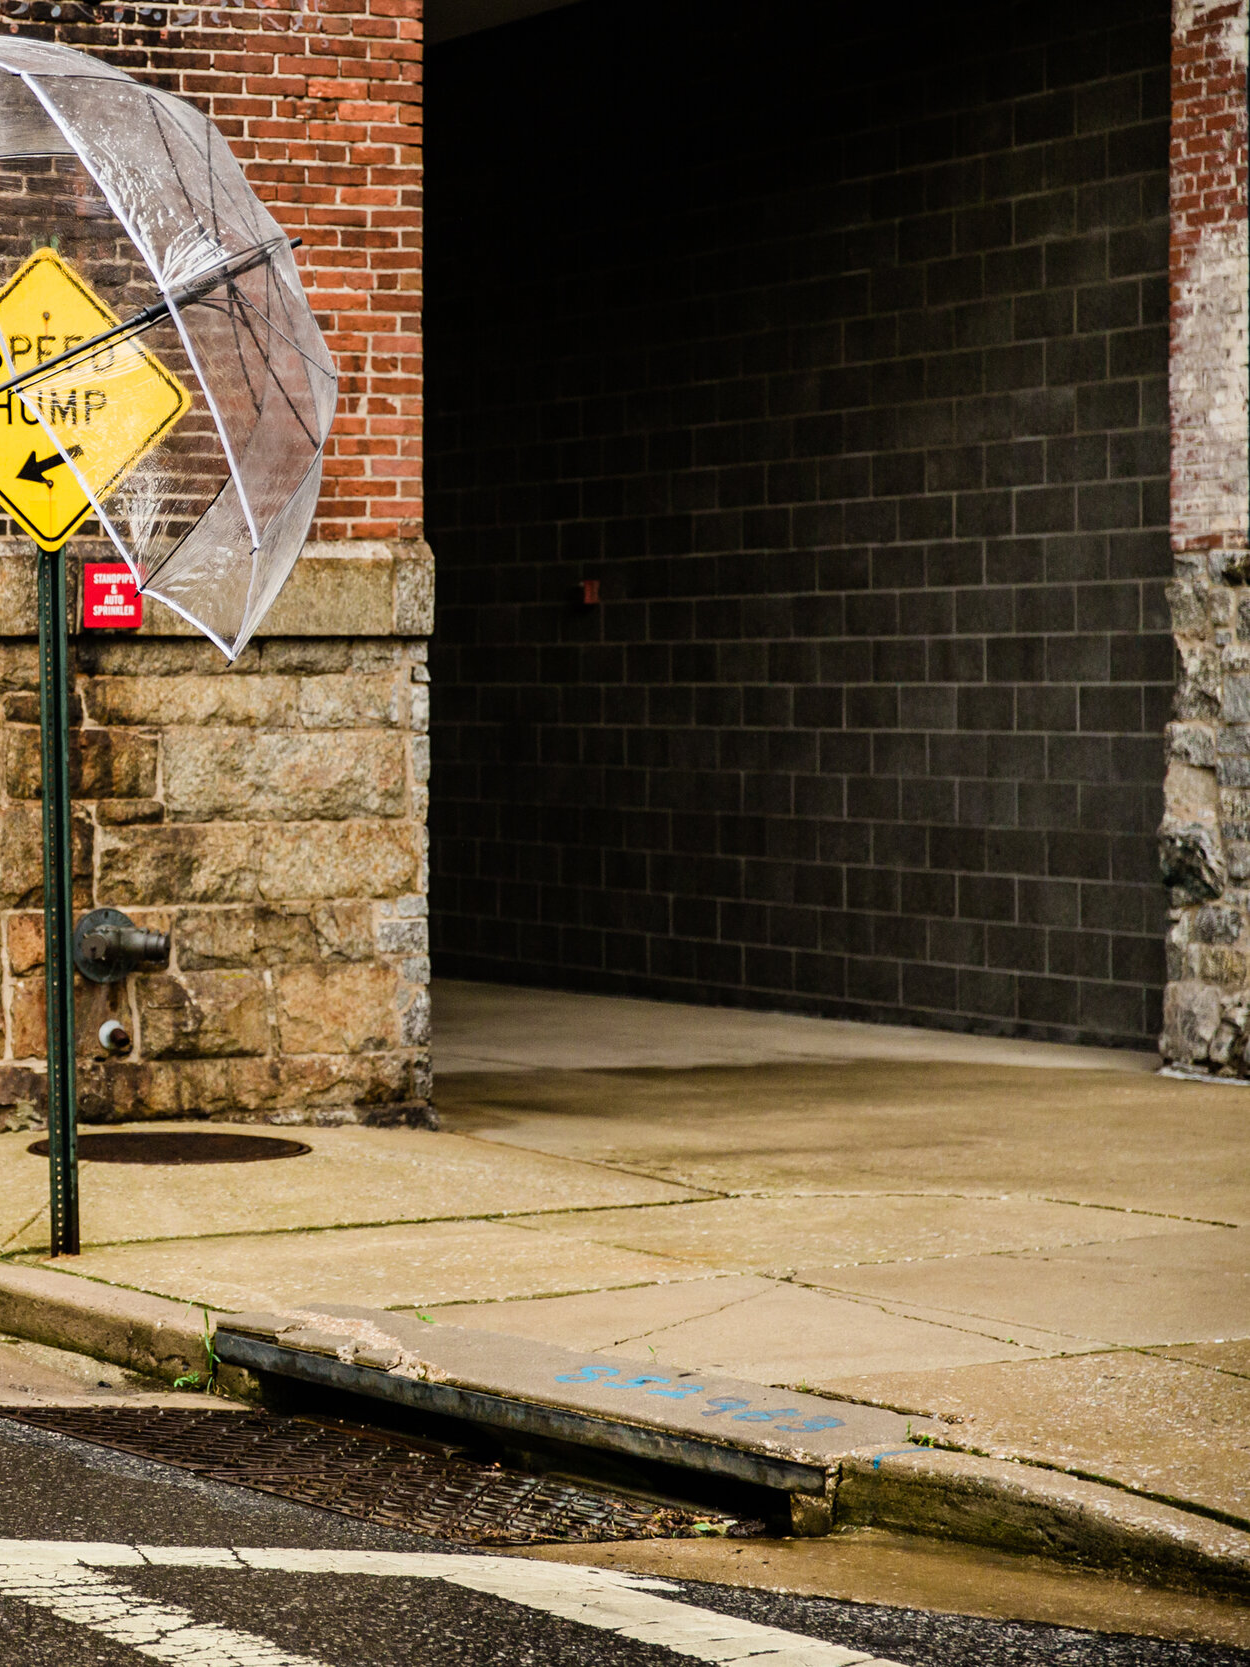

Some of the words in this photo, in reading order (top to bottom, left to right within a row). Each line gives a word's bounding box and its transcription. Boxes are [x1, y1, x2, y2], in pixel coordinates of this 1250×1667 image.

[93, 573, 135, 584] STANDPIPE
[111, 584, 117, 594] &
[104, 594, 124, 605] AUTO
[93, 605, 135, 616] SPRINKLER
